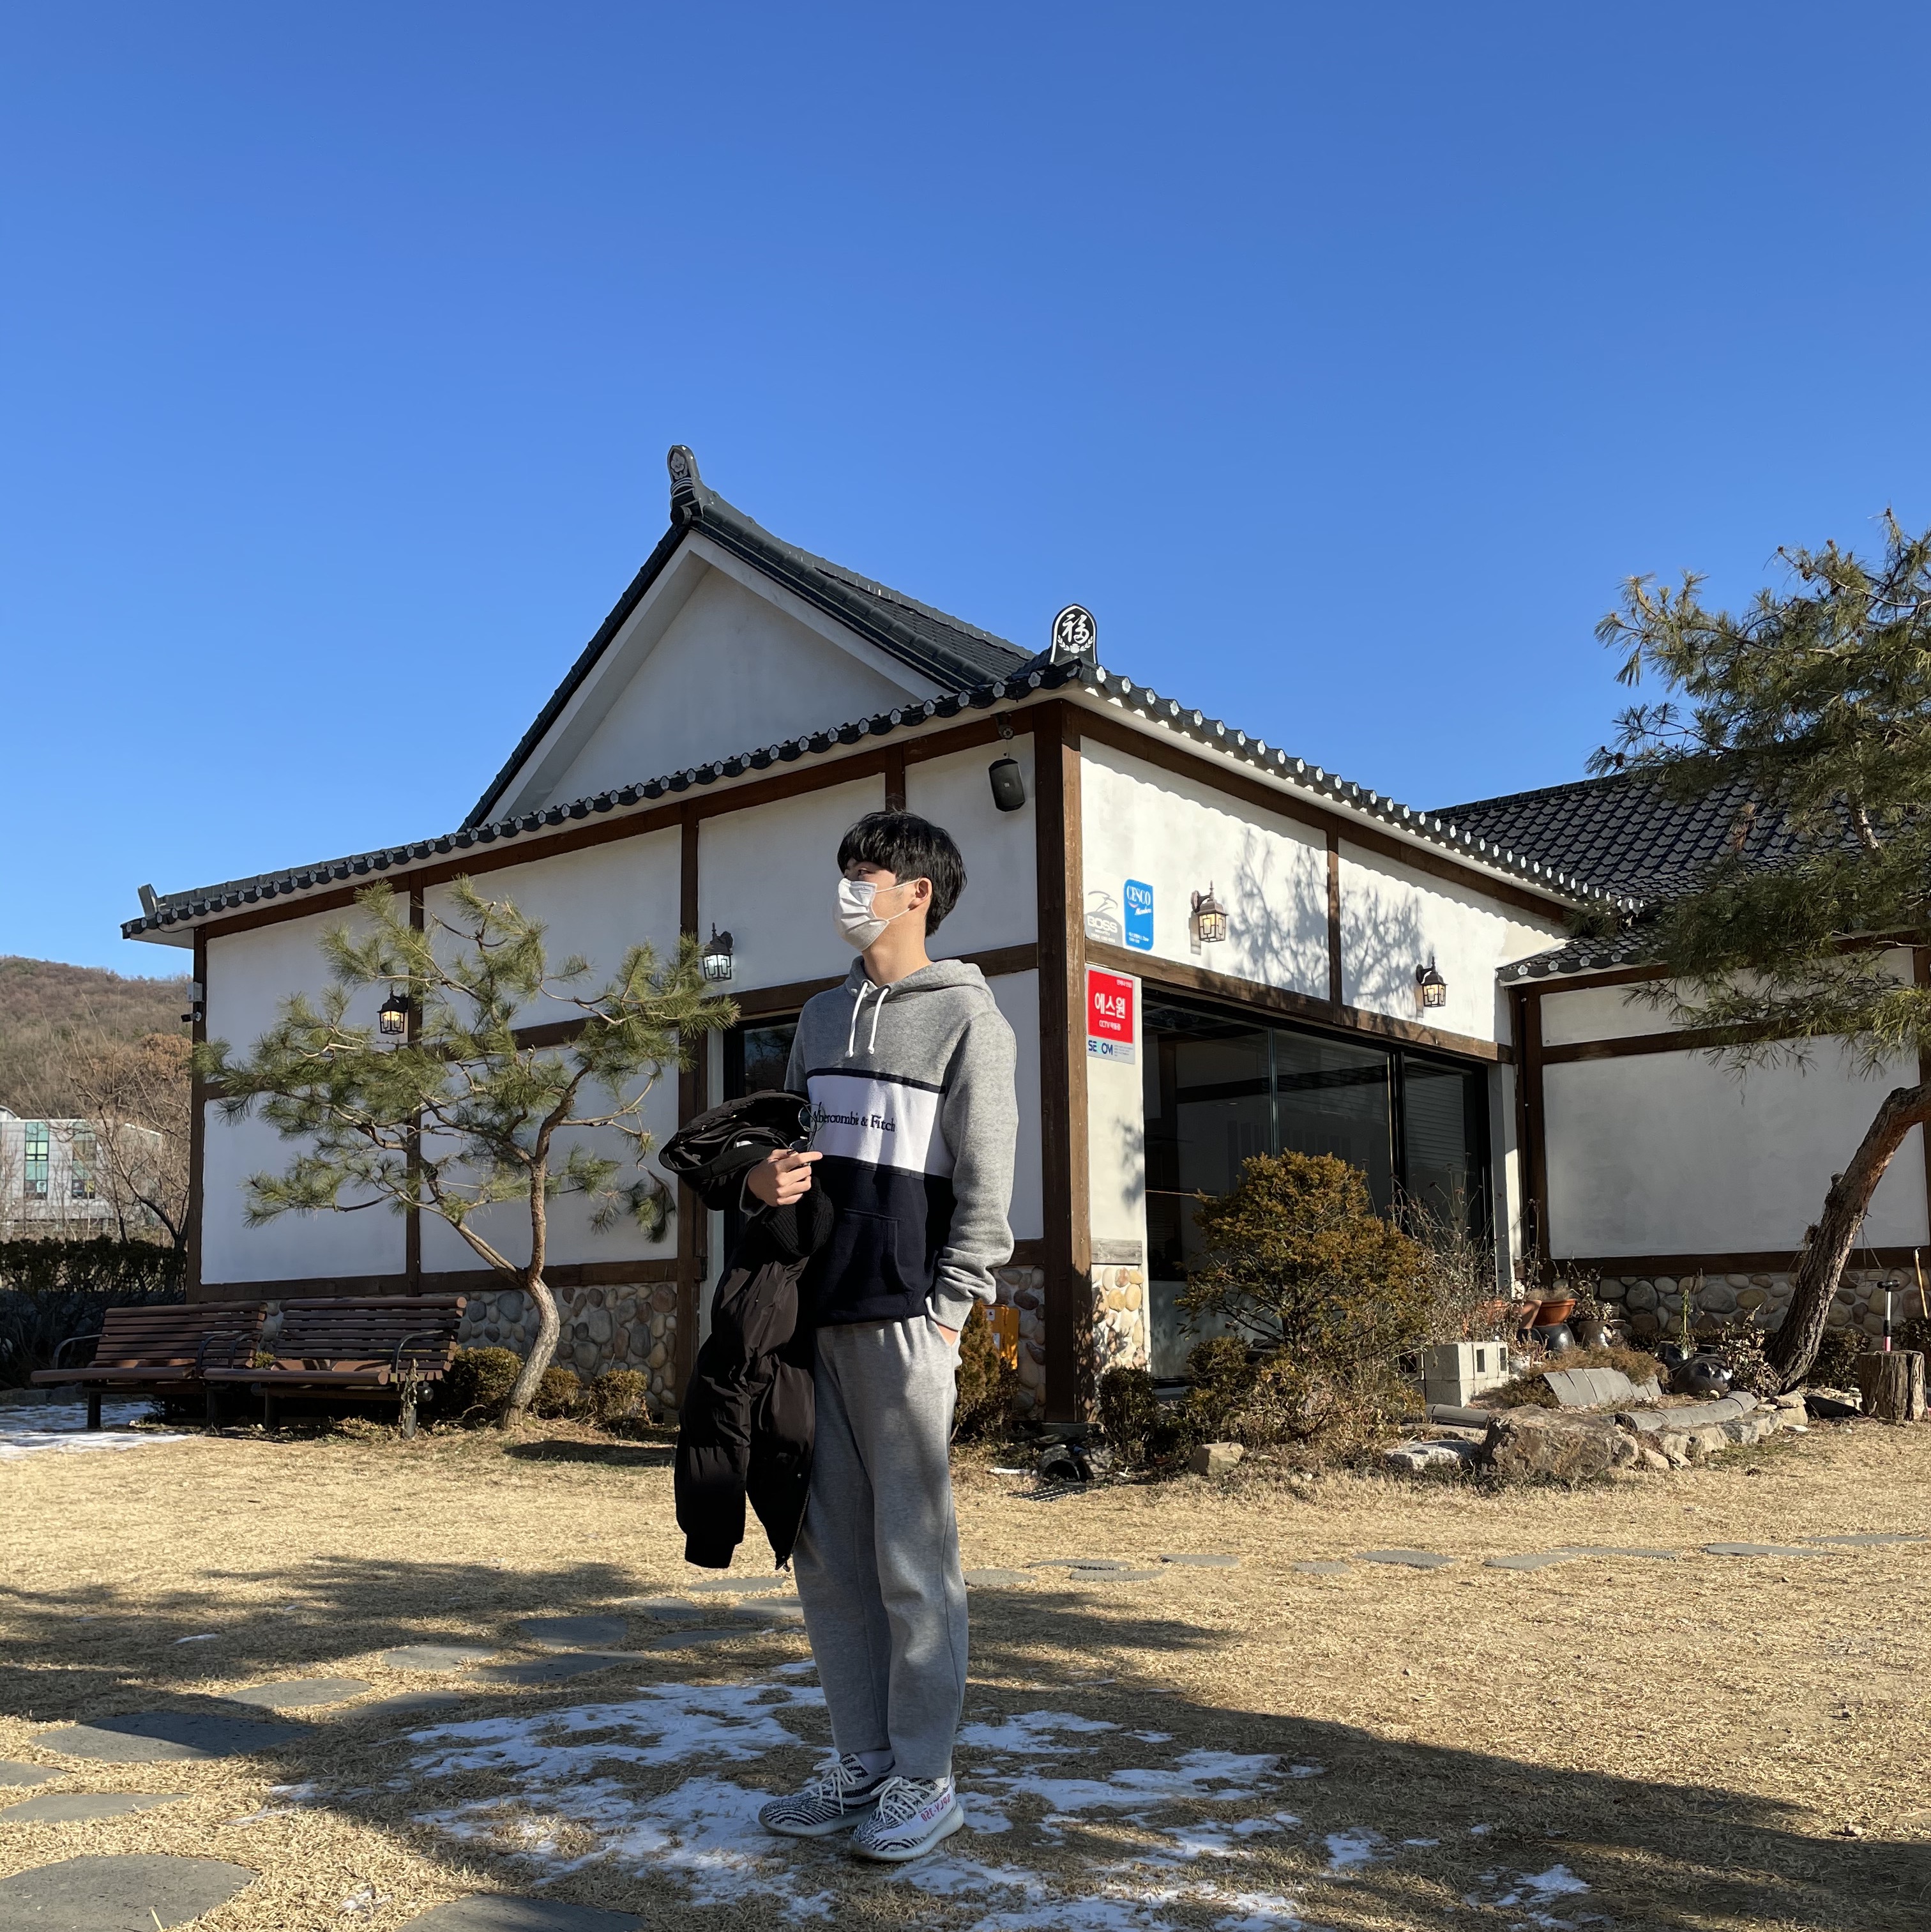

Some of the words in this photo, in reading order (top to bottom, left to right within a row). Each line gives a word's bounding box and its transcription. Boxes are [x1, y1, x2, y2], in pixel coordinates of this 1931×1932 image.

[1126, 885, 1151, 906] CESCO
[1087, 915, 1117, 933] BOSS
[1094, 992, 1126, 1019] 에스원
[1088, 1040, 1113, 1055] SECOM
[861, 1116, 868, 1126] &
[870, 1114, 895, 1132] Fitch
